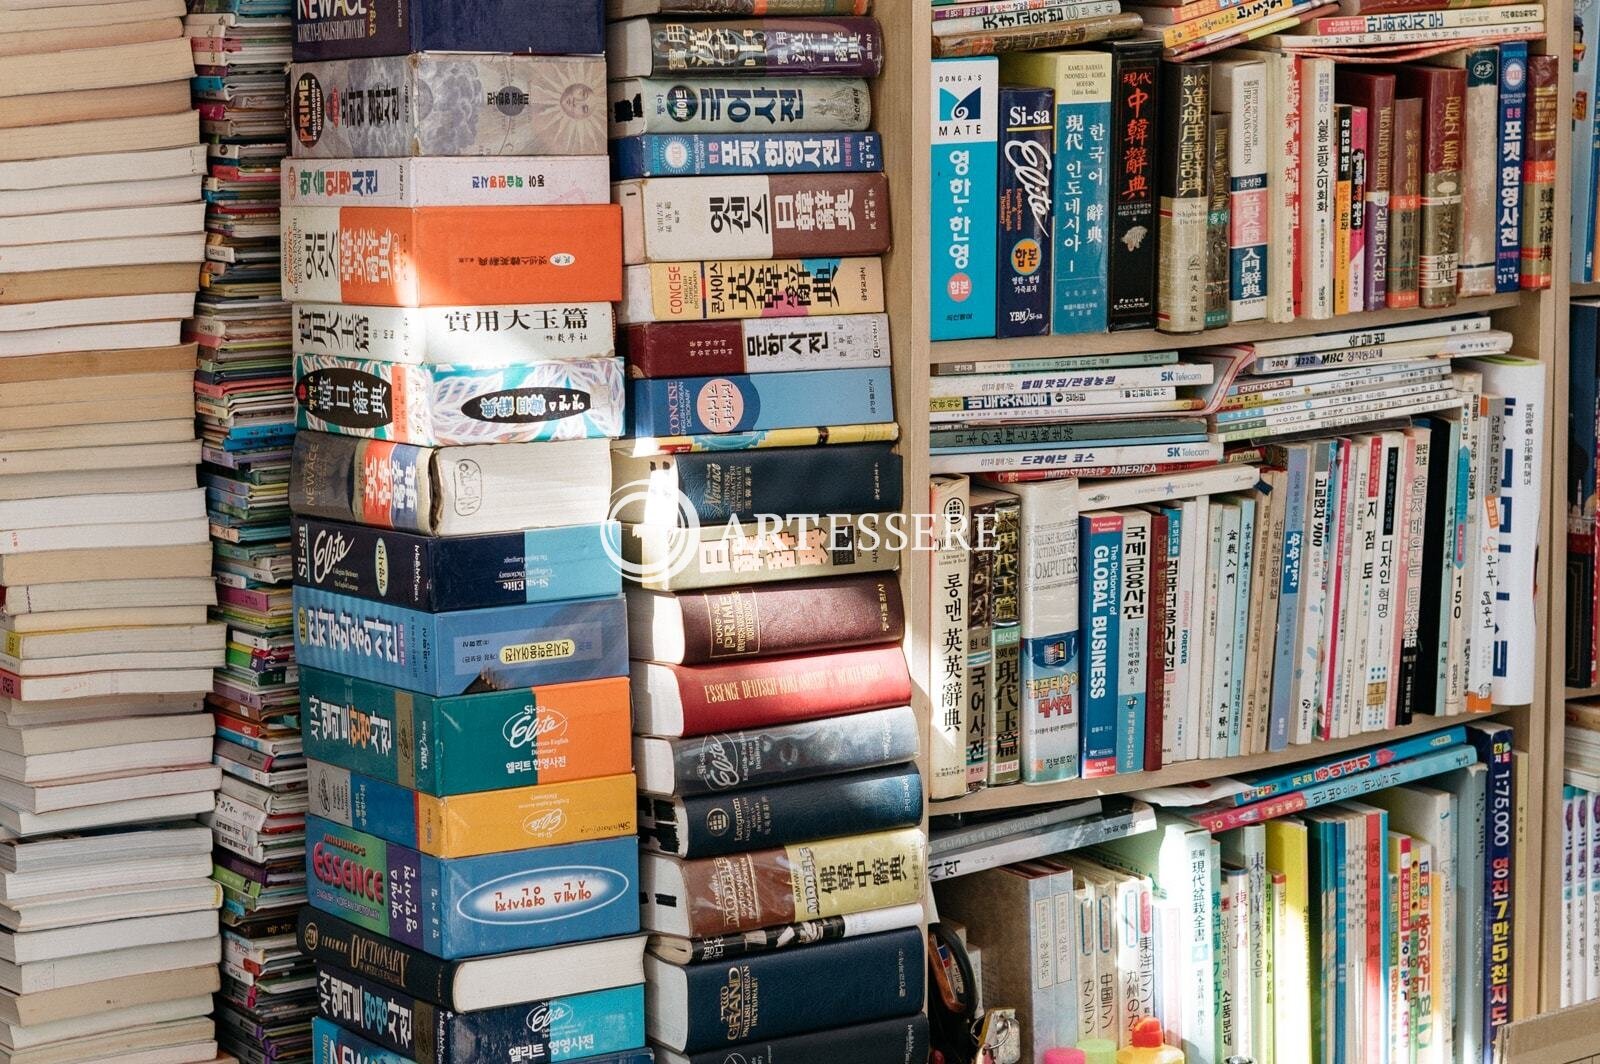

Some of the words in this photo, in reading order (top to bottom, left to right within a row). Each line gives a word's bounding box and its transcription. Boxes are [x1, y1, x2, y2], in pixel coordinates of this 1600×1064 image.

[1366, 10, 1444, 33] 만화천자문
[938, 74, 982, 83] DONG-A'S
[1123, 73, 1152, 87] 現代
[299, 79, 312, 142] PRIME
[674, 89, 689, 119] 메이트
[700, 86, 804, 124] 국어사전
[1009, 106, 1050, 126] Si-sa
[938, 124, 982, 136] MATE
[1065, 115, 1083, 150] 現代
[1122, 88, 1150, 198] 中韓辭典
[1317, 119, 1329, 143] 실용
[1501, 120, 1521, 162] 포켓
[709, 141, 719, 164] 민중
[722, 138, 761, 168] 포켓
[765, 138, 840, 168] 한영사전
[1088, 123, 1105, 186] 한국어
[300, 169, 378, 197] 학습인명사전
[472, 175, 523, 189] 학습인명사전
[528, 175, 545, 187] 동아
[1005, 140, 1052, 237] Elite
[709, 194, 769, 233] 엣센스
[775, 189, 856, 231] 日韓辭典
[1064, 160, 1083, 253] 인도네시아
[1087, 204, 1103, 243] 辭典
[1209, 214, 1228, 224] 동아
[1500, 167, 1521, 247] 한영사전
[305, 229, 339, 280] 엣센스
[1014, 246, 1037, 267] 합본
[1241, 248, 1262, 297] 入門辭典
[670, 266, 681, 315] CONCISE
[710, 262, 725, 314] 콘사이스
[728, 263, 840, 311] 英韓辭典
[949, 278, 969, 296] 합본
[445, 308, 588, 333] 實用大玉篇
[1009, 311, 1027, 322] YBM
[1028, 312, 1042, 320] Si-sa
[747, 331, 829, 357] 문학사전
[1321, 352, 1344, 364] MBC
[1021, 378, 1043, 390] 별미
[1045, 375, 1117, 389] 맛집/관광농원
[1161, 371, 1174, 382] SK
[1176, 372, 1201, 381] Telecom
[318, 376, 387, 418] 韓日辭典
[548, 393, 585, 411] 엣센스
[668, 381, 677, 436] CONCISE
[1525, 403, 1535, 437] 출제문제
[1020, 454, 1067, 465] 드라이브
[1072, 452, 1095, 464] 코스
[1043, 469, 1066, 478] UNITED
[1109, 464, 1157, 475] AMERICA
[1167, 447, 1180, 457] SK
[1182, 447, 1209, 457] Telecom
[1524, 438, 1533, 486] 도로교통공단
[1313, 478, 1327, 519] 고교한자
[1410, 475, 1427, 513] 혼자
[297, 525, 307, 578] Si-sa
[1111, 544, 1119, 561] The
[1312, 522, 1325, 548] 900
[1362, 501, 1378, 580] 지점토
[1407, 517, 1424, 578] 배우는
[314, 529, 356, 583] Elite
[1123, 526, 1146, 620] 국제금융사전
[1379, 540, 1393, 585] 디자인
[1485, 537, 1499, 586] 날아라
[503, 580, 524, 590] Elite
[526, 579, 549, 589] Si-sa
[943, 573, 963, 622] 롱맨
[1092, 545, 1109, 613] GLOBAL
[1110, 562, 1118, 606] Dictionary
[1453, 575, 1463, 619] 150
[720, 596, 736, 648] PRIME
[1109, 607, 1116, 616] of
[1481, 591, 1497, 630] 병아리
[505, 642, 570, 661] 전자공학용어사전
[1090, 617, 1108, 699] BUSINESS
[1180, 630, 1188, 665] FOREVER
[704, 682, 740, 704] ESSENCE
[743, 676, 777, 700] DEUTSCH
[942, 628, 963, 732] 英英辭典
[309, 695, 321, 741] 시사
[969, 666, 988, 761] 국어사전
[995, 662, 1018, 756] 現代玉篇
[510, 715, 556, 747] Elite
[420, 742, 428, 770] YBM
[506, 761, 530, 774] 엘리트
[532, 756, 566, 770] 한영사전
[707, 736, 740, 787] Elite
[1314, 755, 1371, 781] 종이접기
[528, 808, 562, 831] Elite
[732, 798, 744, 841] Longman
[1493, 770, 1510, 847] 1:75,000
[313, 841, 385, 905] ESSENCE
[554, 880, 592, 902] 엣센스
[799, 848, 819, 915] MODELE
[821, 855, 906, 895] 佛韓中辭典
[390, 869, 403, 918] 엣센스
[404, 865, 418, 932] 영한사전
[494, 886, 546, 912] 영한사전
[350, 934, 410, 987] DICTIONARY
[1139, 936, 1153, 1004] 東洋ラン
[320, 971, 330, 1014] 시사
[728, 967, 742, 1041] GRAND
[750, 976, 758, 1027] DICTIONARY
[1083, 978, 1094, 1034] カンラン
[1100, 972, 1114, 1029] 中国ラン
[509, 1043, 544, 1062] 엘리트
[549, 1034, 594, 1055] 영영사전
